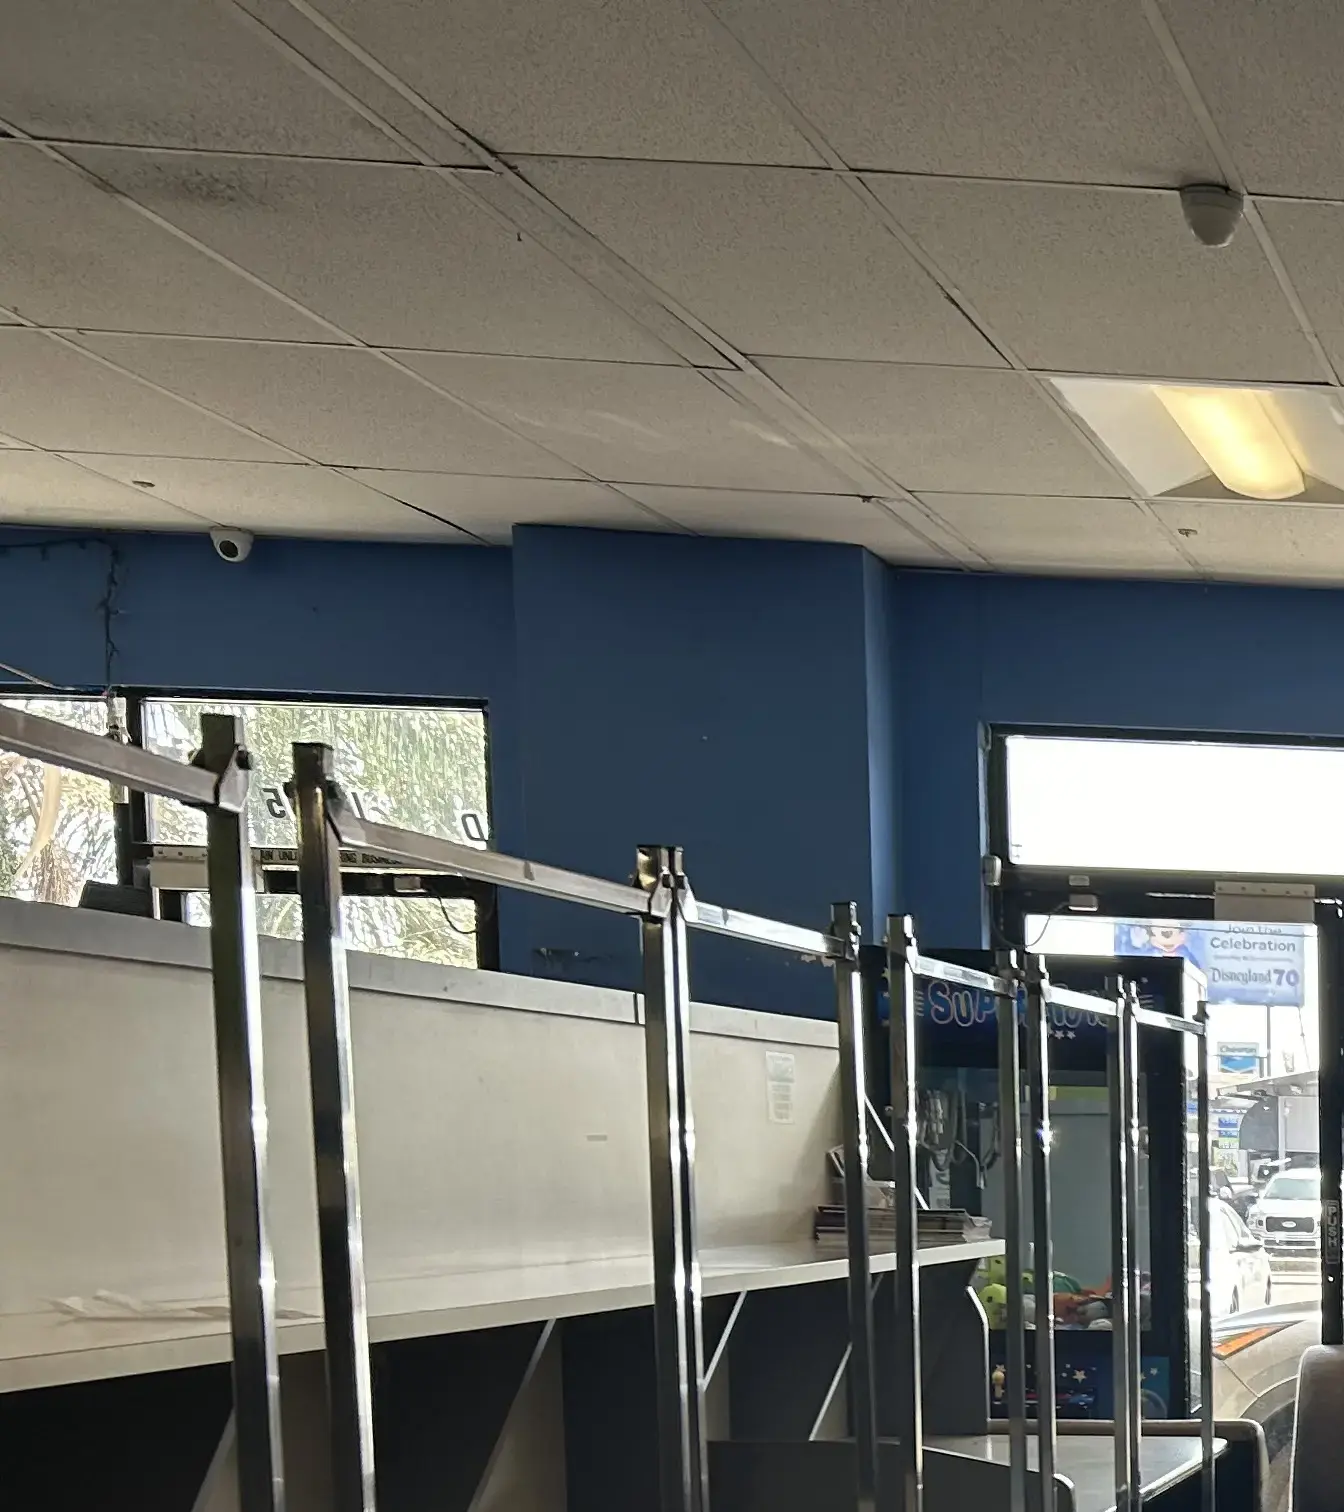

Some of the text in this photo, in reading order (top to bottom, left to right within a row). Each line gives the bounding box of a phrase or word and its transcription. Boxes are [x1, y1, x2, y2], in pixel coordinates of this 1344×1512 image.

[1210, 937, 1296, 952] Celebration
[1209, 967, 1300, 986] Disneyland 70
[1327, 1205, 1338, 1247] PUSH
